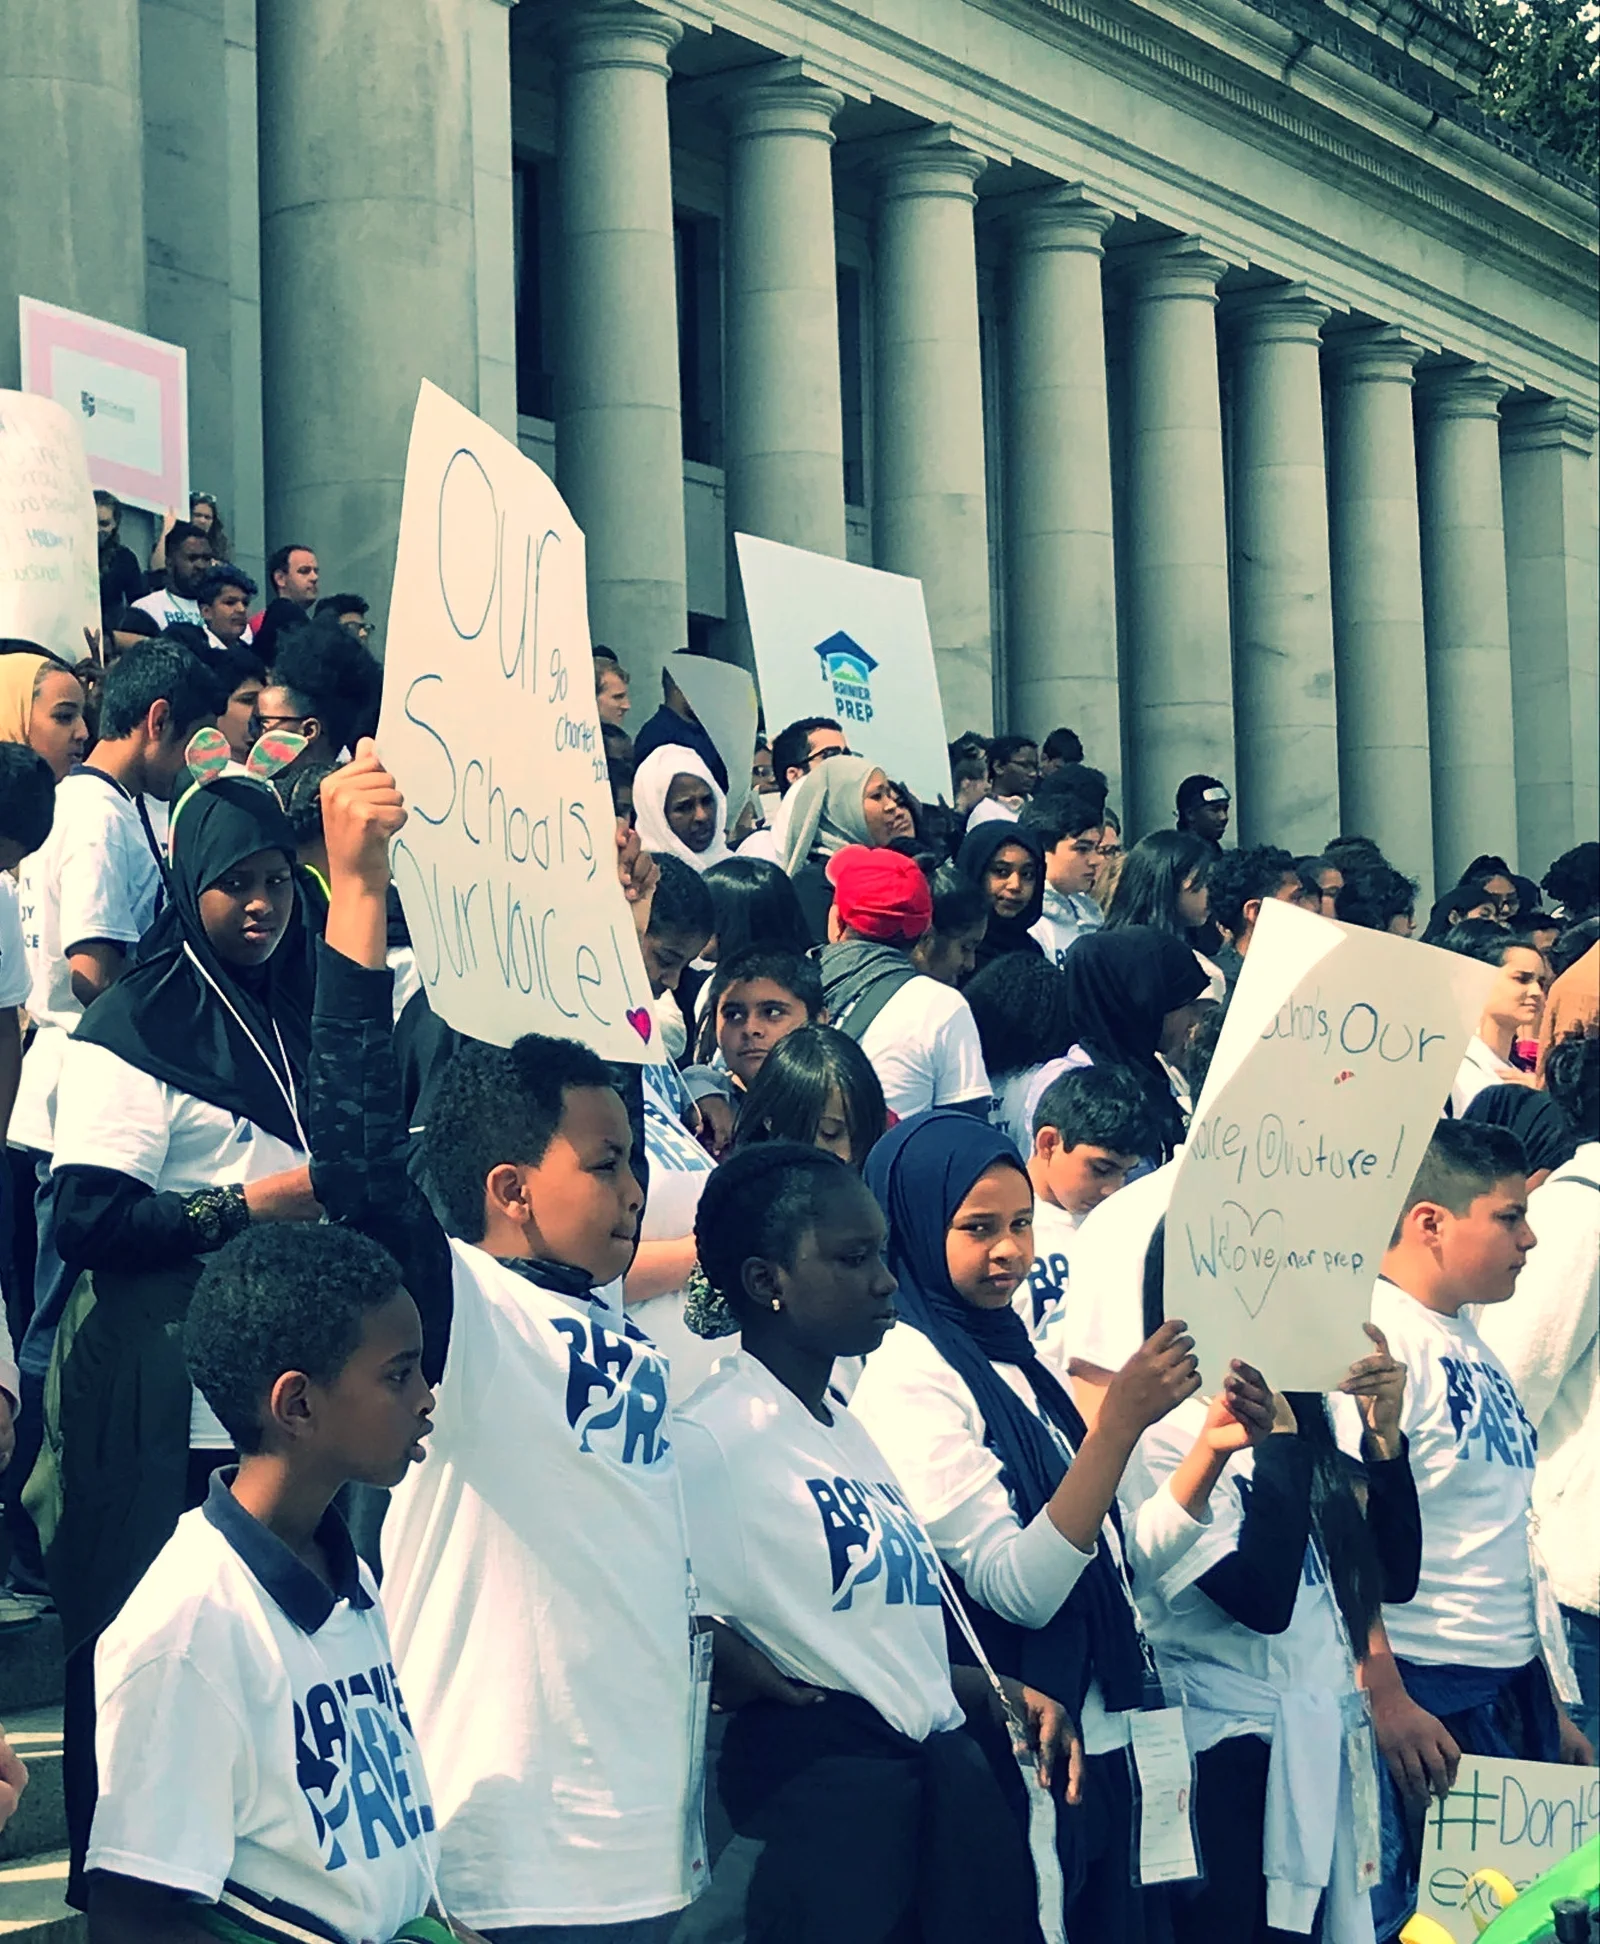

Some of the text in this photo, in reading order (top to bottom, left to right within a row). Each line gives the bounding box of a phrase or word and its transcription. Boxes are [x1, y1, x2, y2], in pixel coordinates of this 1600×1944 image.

[438, 447, 562, 694] Our
[835, 697, 874, 723] PREP
[1340, 1002, 1446, 1062] Our
[1323, 1250, 1364, 1276] prep
